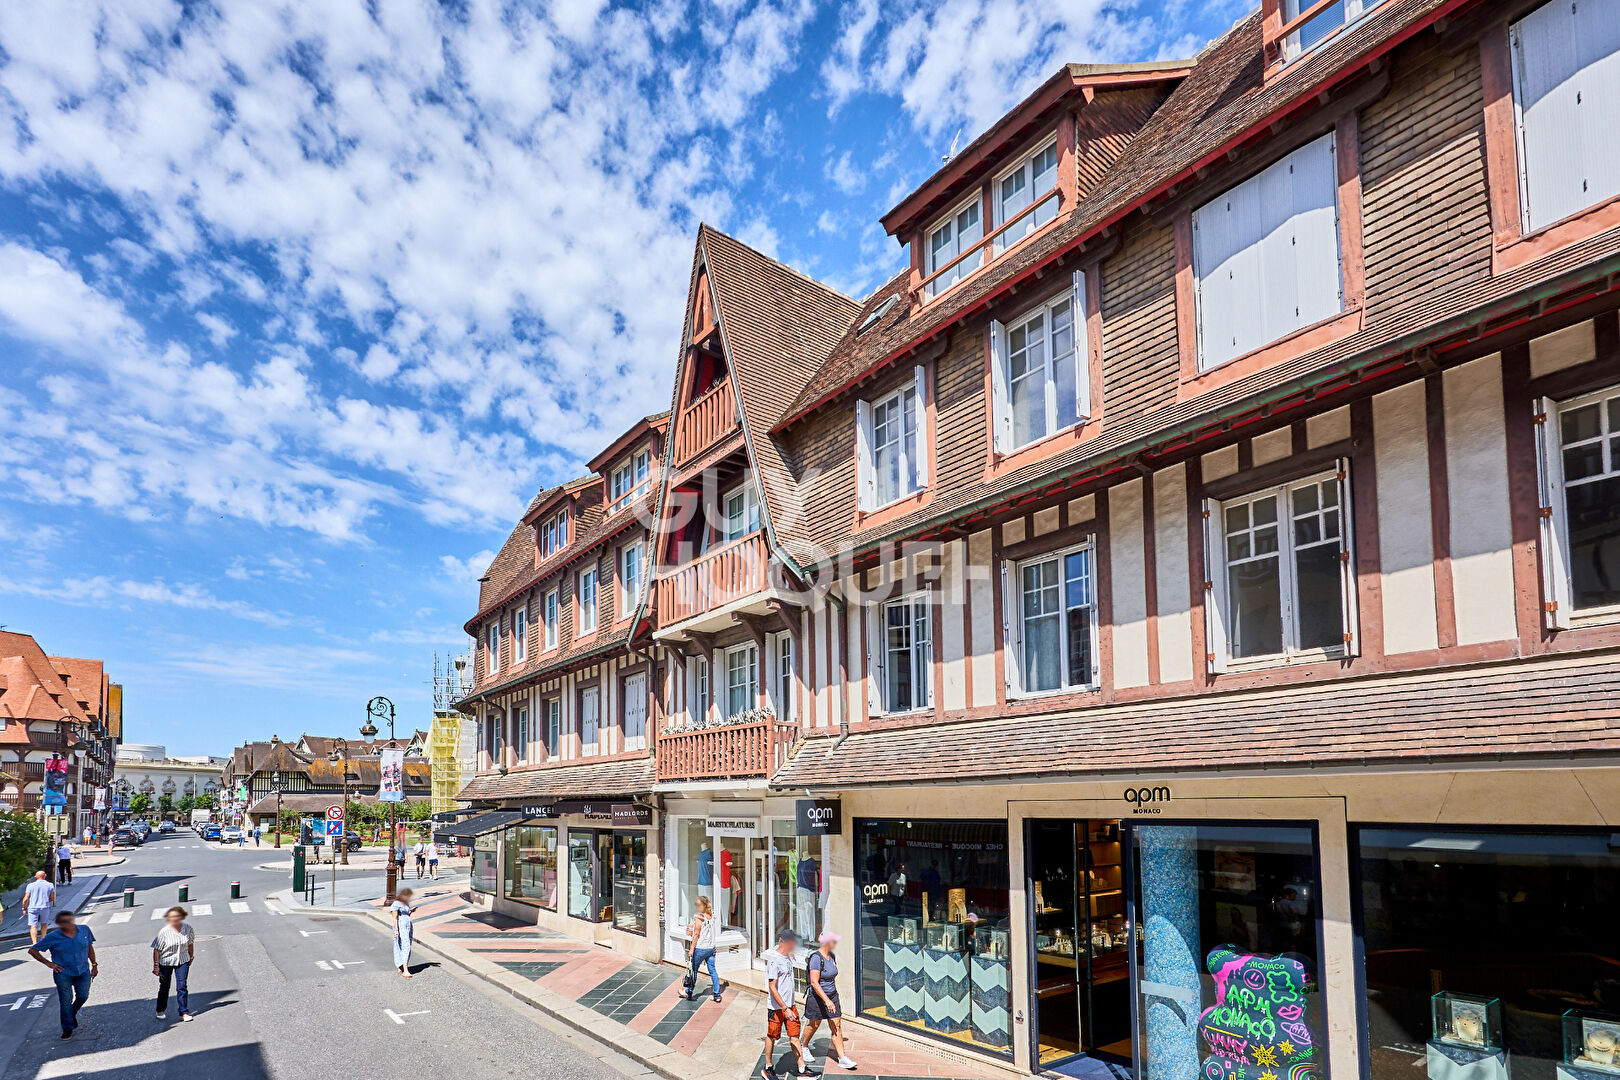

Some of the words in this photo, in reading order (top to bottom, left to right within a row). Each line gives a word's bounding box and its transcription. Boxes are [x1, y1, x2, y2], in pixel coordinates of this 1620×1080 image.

[1124, 786, 1171, 807] apm
[807, 807, 833, 822] apm
[863, 883, 888, 899] apm
